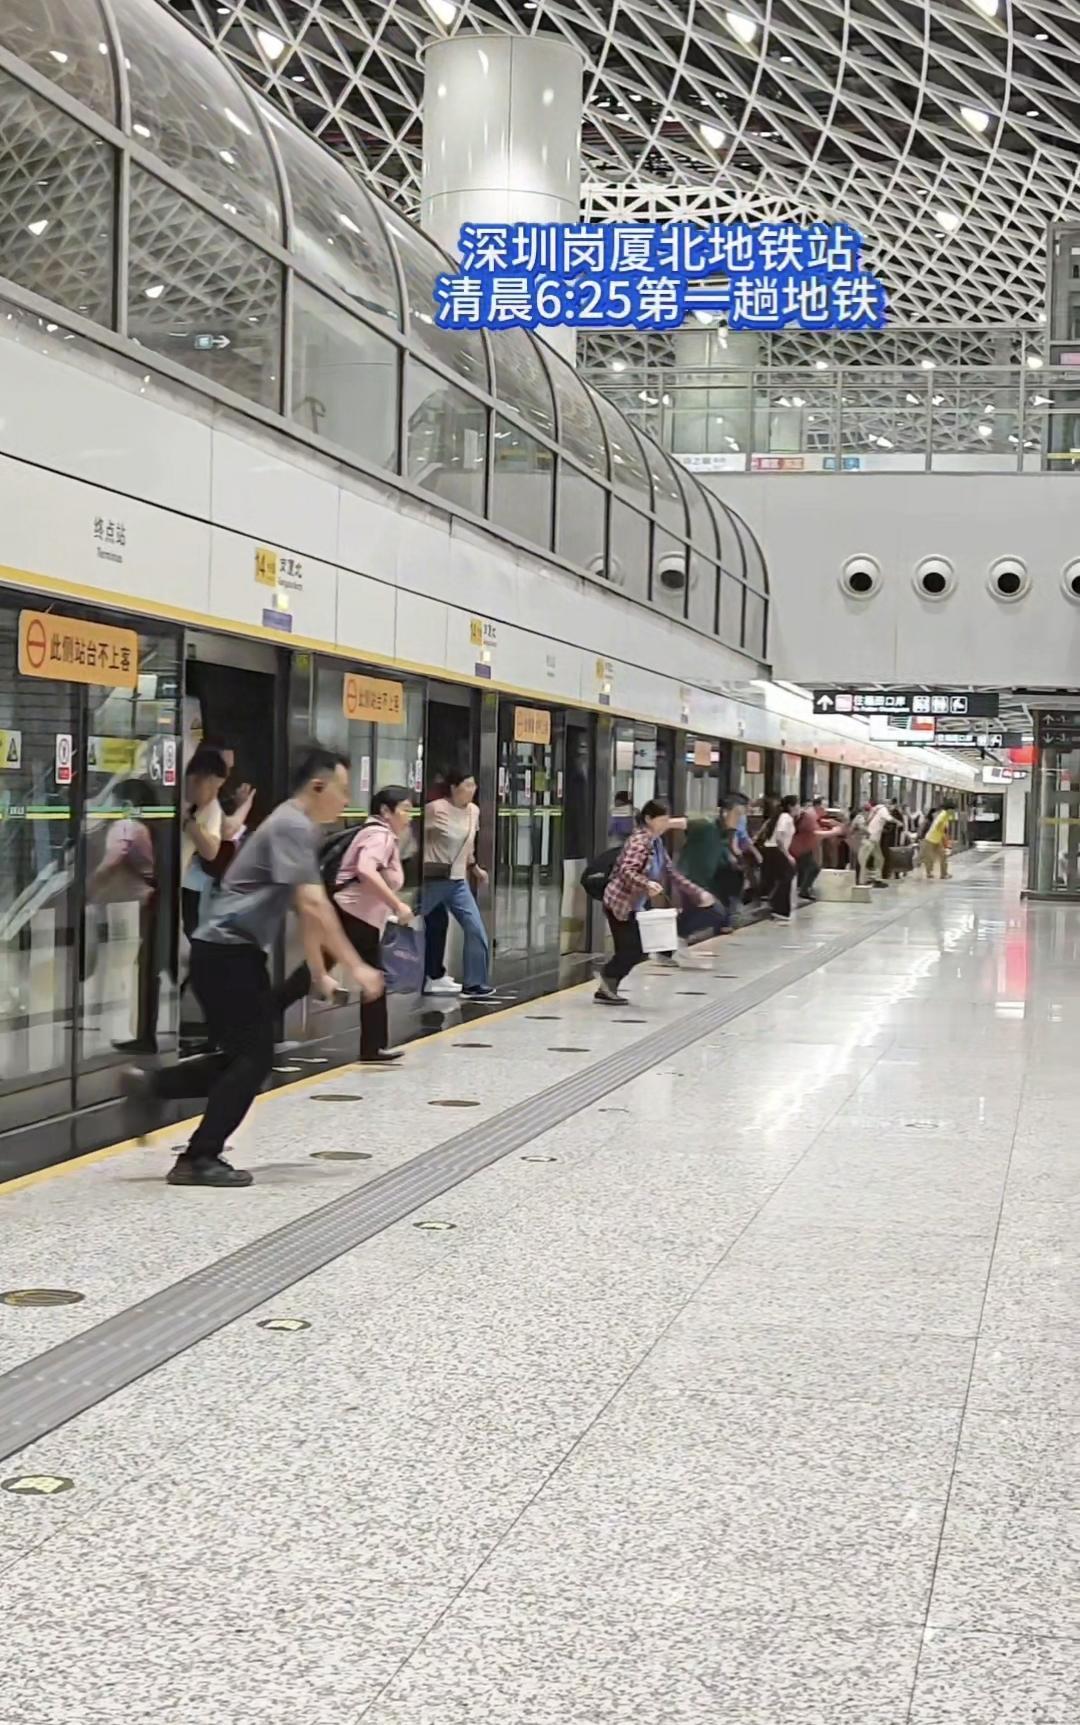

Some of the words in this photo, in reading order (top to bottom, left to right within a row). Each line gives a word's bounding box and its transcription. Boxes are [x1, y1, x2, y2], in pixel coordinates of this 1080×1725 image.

[93, 516, 126, 546] 终点站
[50, 632, 132, 672] 此侧站台不上客
